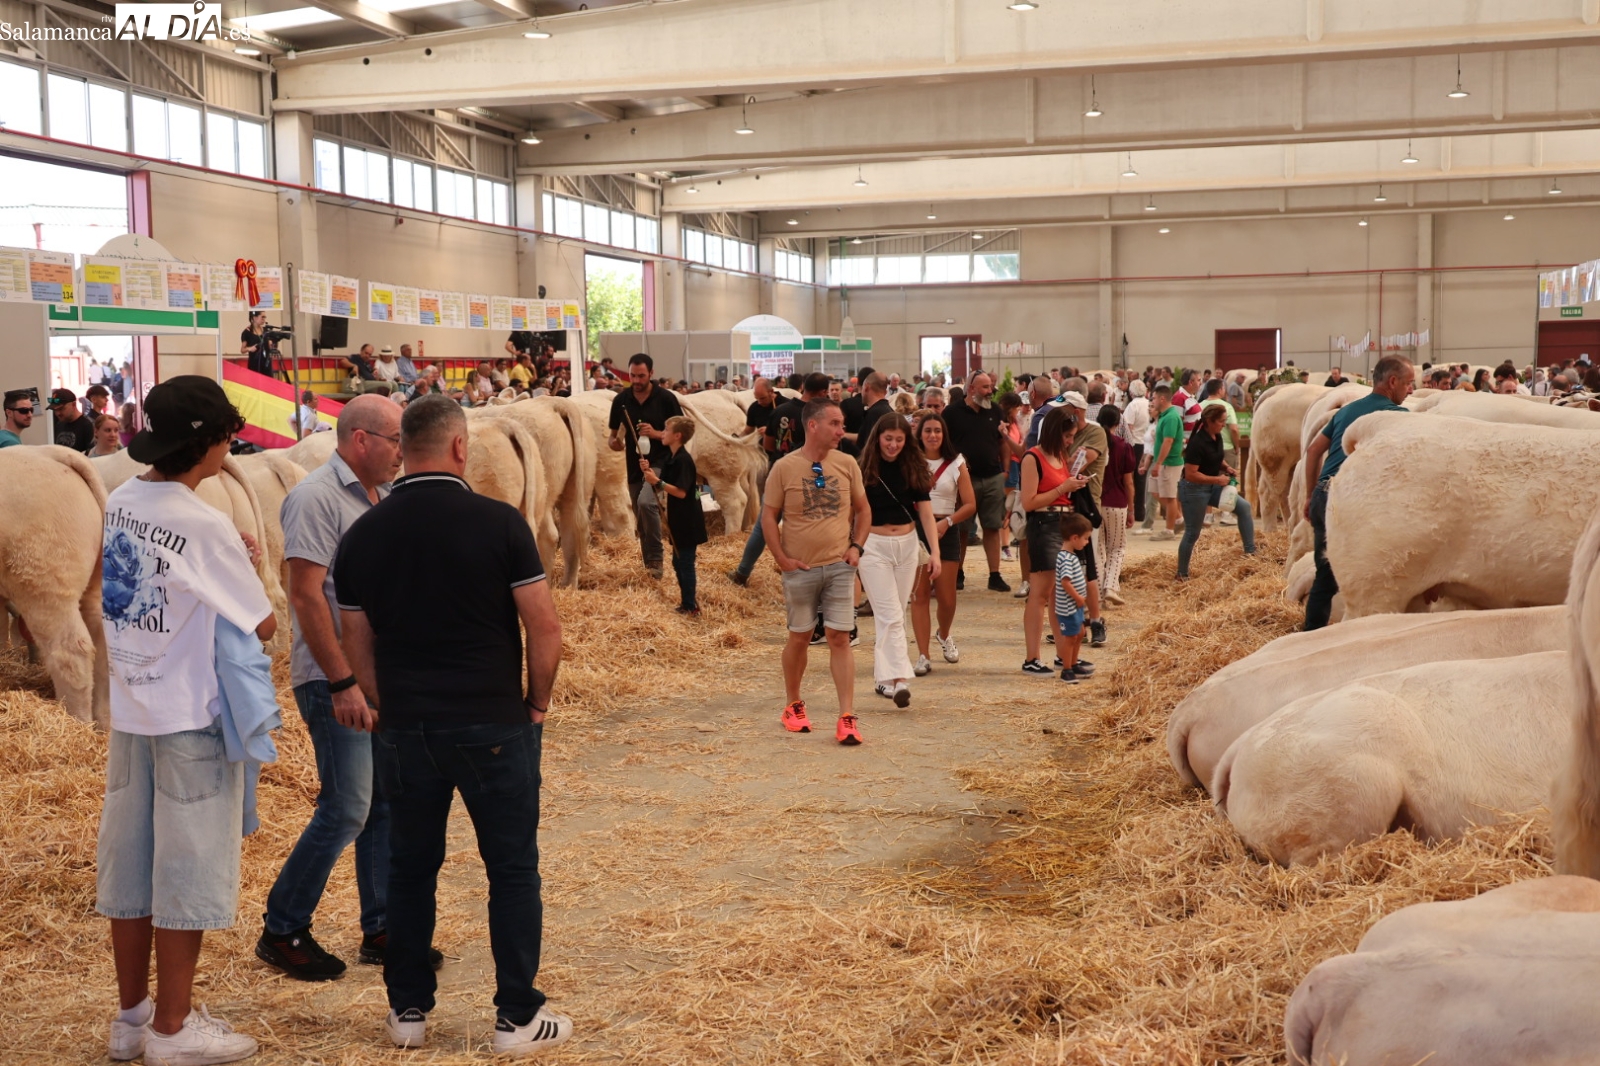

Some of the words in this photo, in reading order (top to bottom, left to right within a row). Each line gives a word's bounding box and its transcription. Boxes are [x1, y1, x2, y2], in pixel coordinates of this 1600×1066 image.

[756, 351, 772, 359] PESO
[773, 350, 793, 358] JUSTO
[150, 525, 187, 556] can
